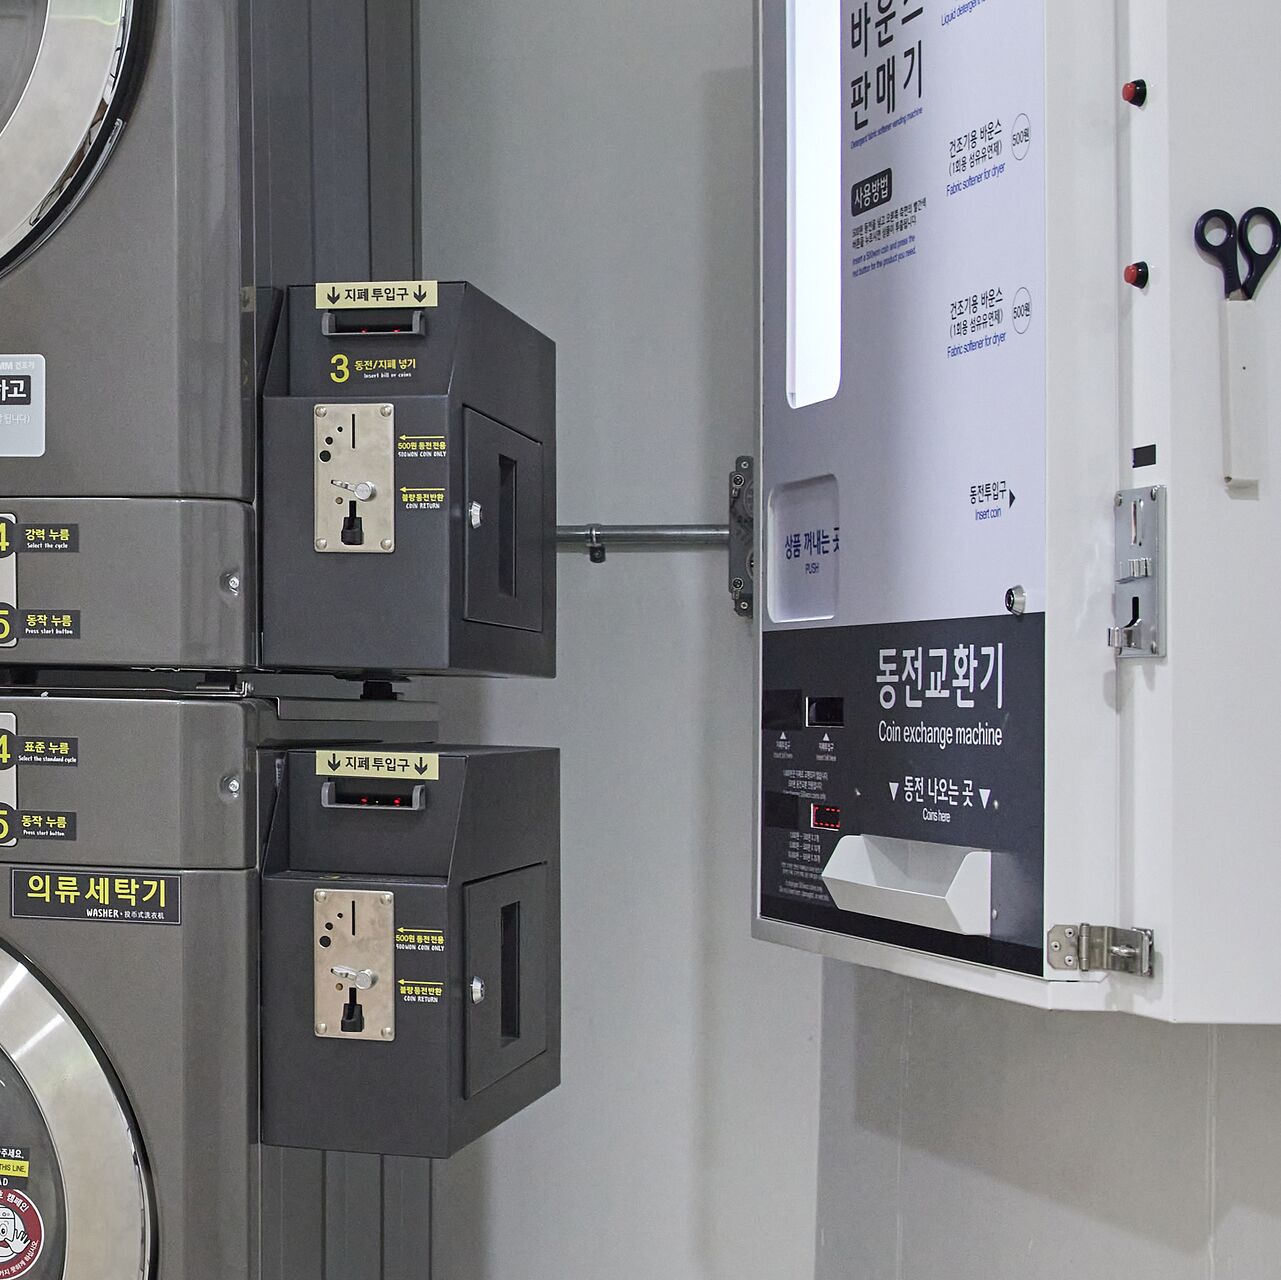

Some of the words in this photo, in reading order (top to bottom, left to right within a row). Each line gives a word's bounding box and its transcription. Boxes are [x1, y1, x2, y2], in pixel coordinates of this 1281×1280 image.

[851, 40, 921, 130] 판매기
[950, 130, 977, 158] 건조기용
[980, 119, 1001, 142] 바운스
[855, 175, 888, 208] 사용방법
[345, 288, 368, 301] 지폐
[371, 288, 408, 301] 투입구
[951, 295, 978, 320] 건조기용
[981, 288, 1003, 309] 바운스
[1014, 303, 1030, 319] 500원
[330, 354, 349, 383] 3
[970, 481, 1006, 504] 동전투입구
[25, 529, 45, 540] 강력
[49, 529, 70, 540] 누름
[785, 534, 801, 559] 상품
[27, 615, 47, 626] 동작
[51, 615, 72, 626] 누름
[876, 643, 1002, 709] 동전교환기
[879, 721, 900, 742] Coin
[903, 721, 952, 749] exchange
[956, 722, 1002, 746] machine
[24, 742, 45, 753] 표준
[49, 742, 69, 754] 누름
[345, 757, 369, 770] 지폐
[372, 758, 409, 772] 투입구
[904, 776, 924, 802] 동전
[928, 778, 958, 805] 나오는
[962, 780, 973, 807] 곳
[22, 815, 42, 828] 동작
[46, 816, 67, 828] 누름
[923, 808, 938, 821] Coins
[938, 811, 950, 822] here
[27, 875, 166, 907] 의류세탁기
